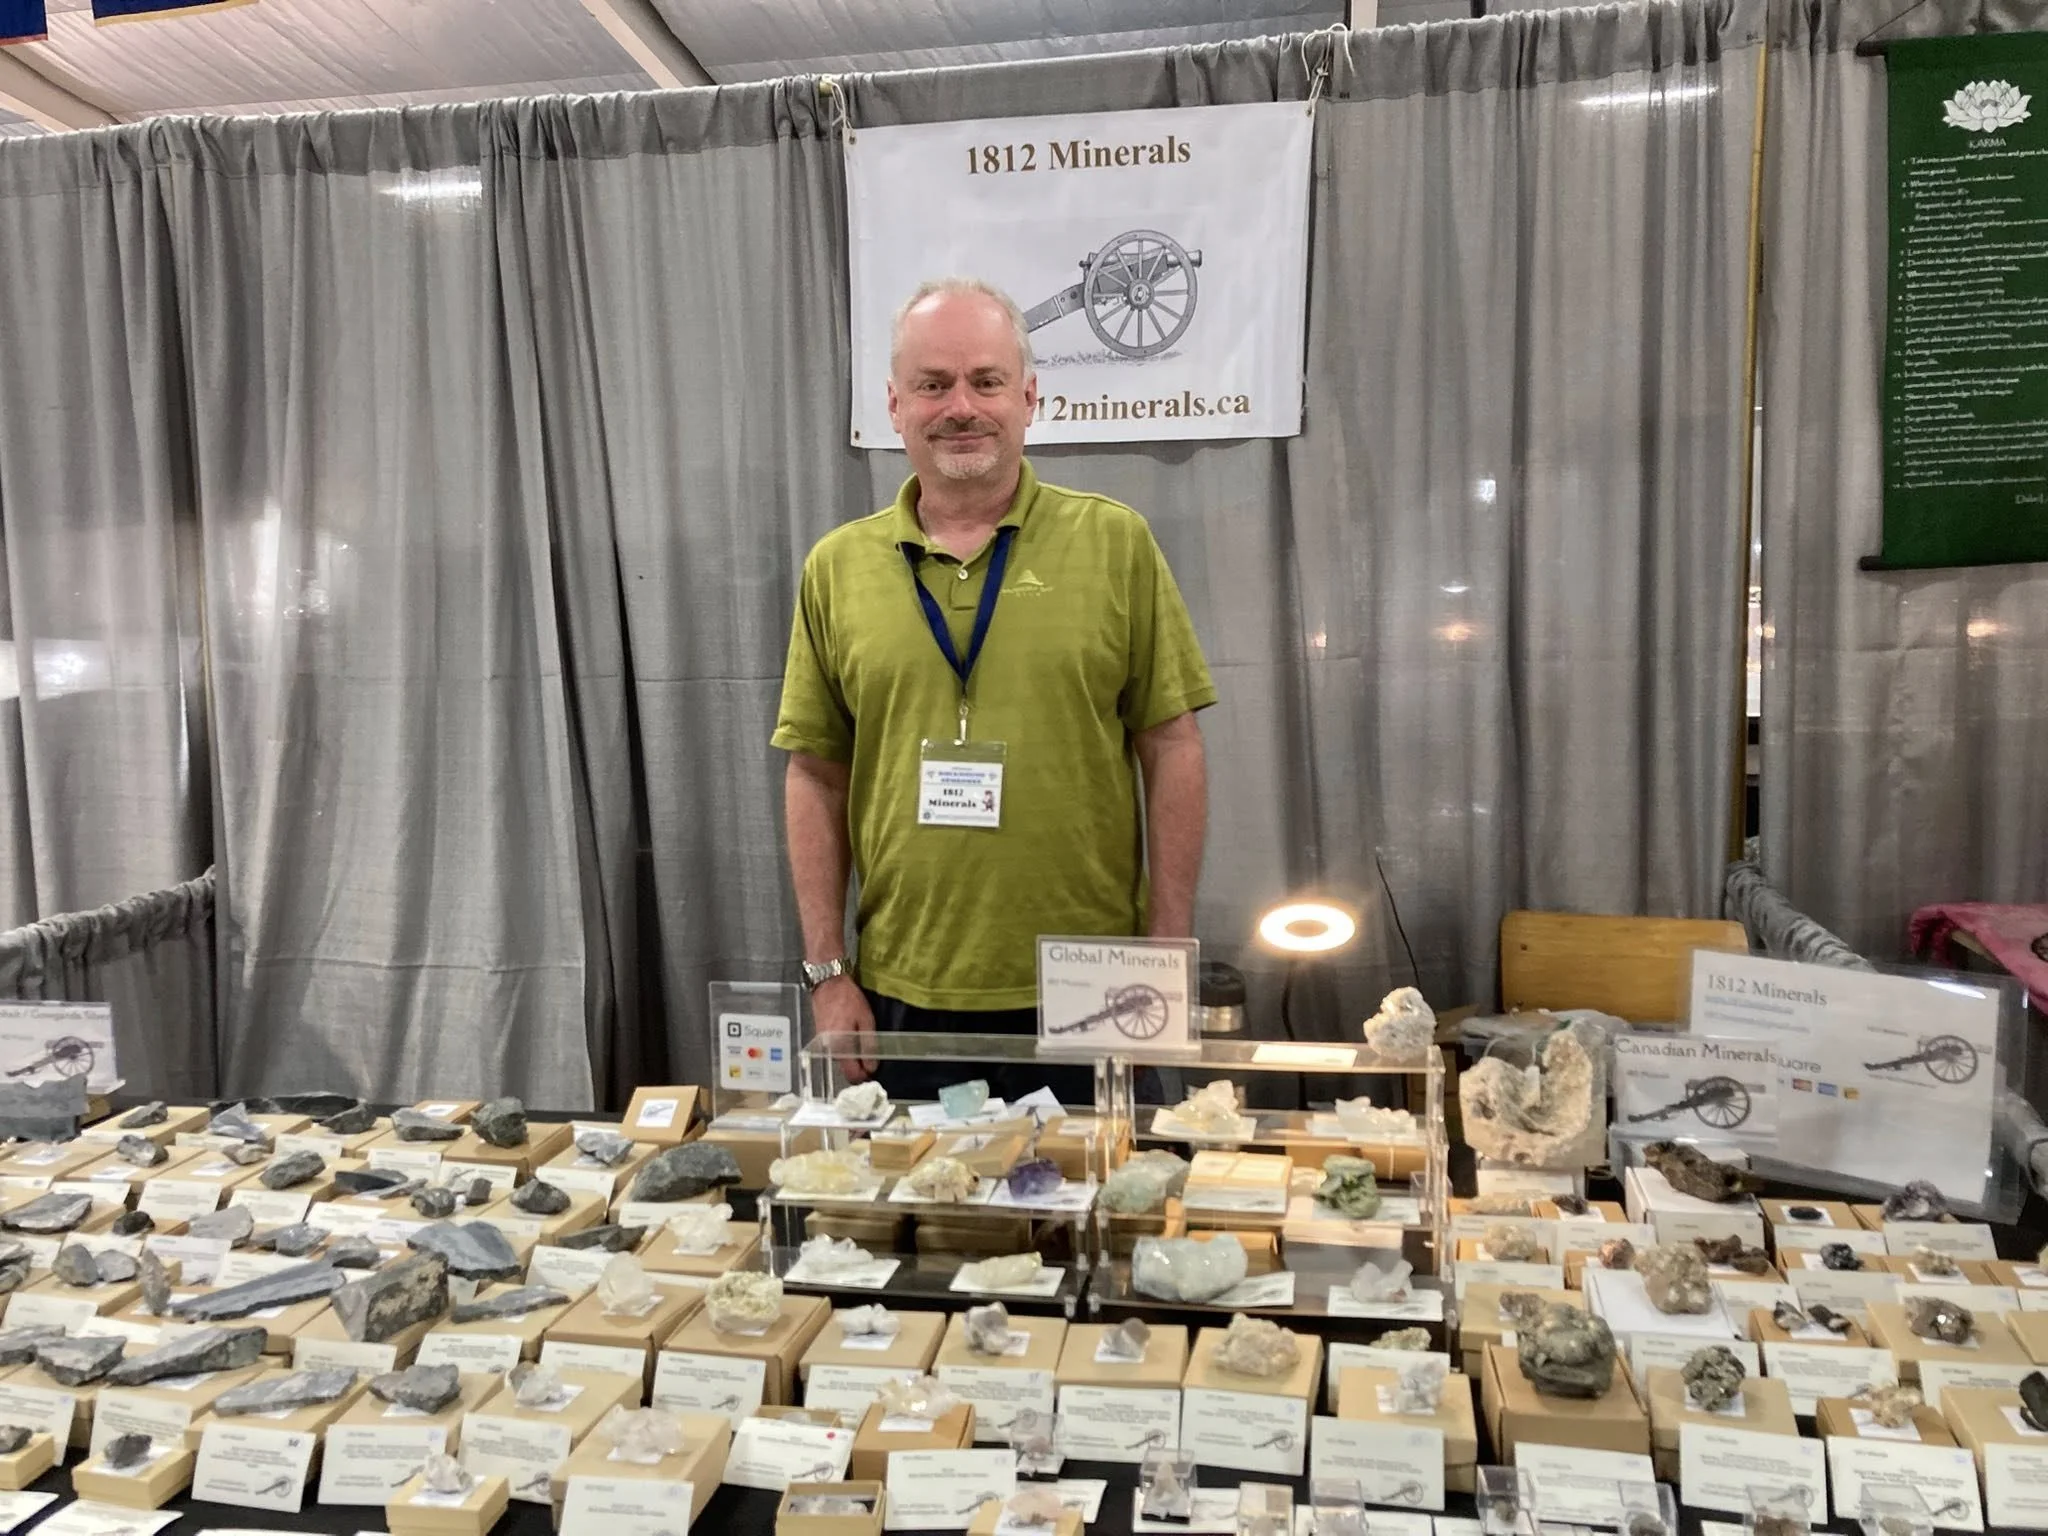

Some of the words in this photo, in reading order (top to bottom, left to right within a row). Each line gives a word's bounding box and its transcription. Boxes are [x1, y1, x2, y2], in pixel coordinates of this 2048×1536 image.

[966, 143, 1036, 174] 1812
[1048, 135, 1191, 170] Minerals
[1036, 391, 1250, 421] 12minerals.ca
[928, 799, 977, 808] Minerals
[1049, 944, 1102, 965] Global
[1108, 949, 1179, 969] Minerals
[1708, 974, 1746, 993] 1812
[1752, 980, 1827, 1007] Minerals
[744, 1024, 783, 1038] Square
[1616, 1038, 1697, 1058] Canadian
[1701, 1043, 1777, 1064] Minerals
[1778, 1056, 1822, 1074] uare
